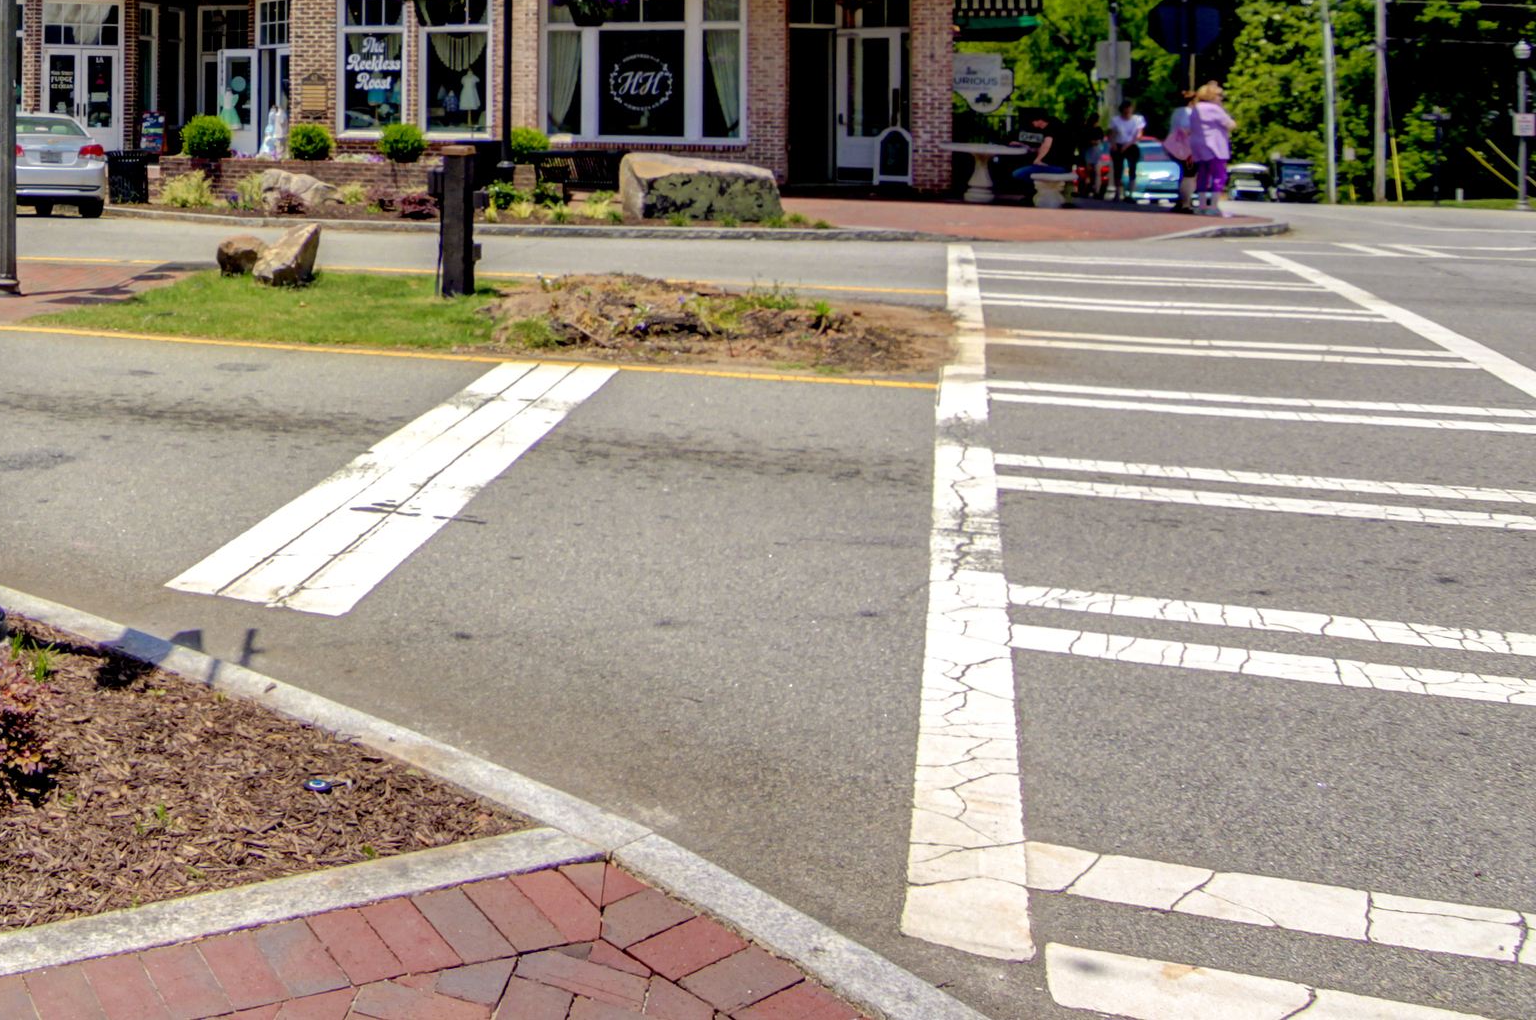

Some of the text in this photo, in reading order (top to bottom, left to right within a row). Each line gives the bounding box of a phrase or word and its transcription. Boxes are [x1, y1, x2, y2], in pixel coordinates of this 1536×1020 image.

[362, 36, 385, 53] The
[346, 53, 401, 71] Reckless
[355, 72, 392, 90] Roost
[954, 77, 998, 86] URIOUS
